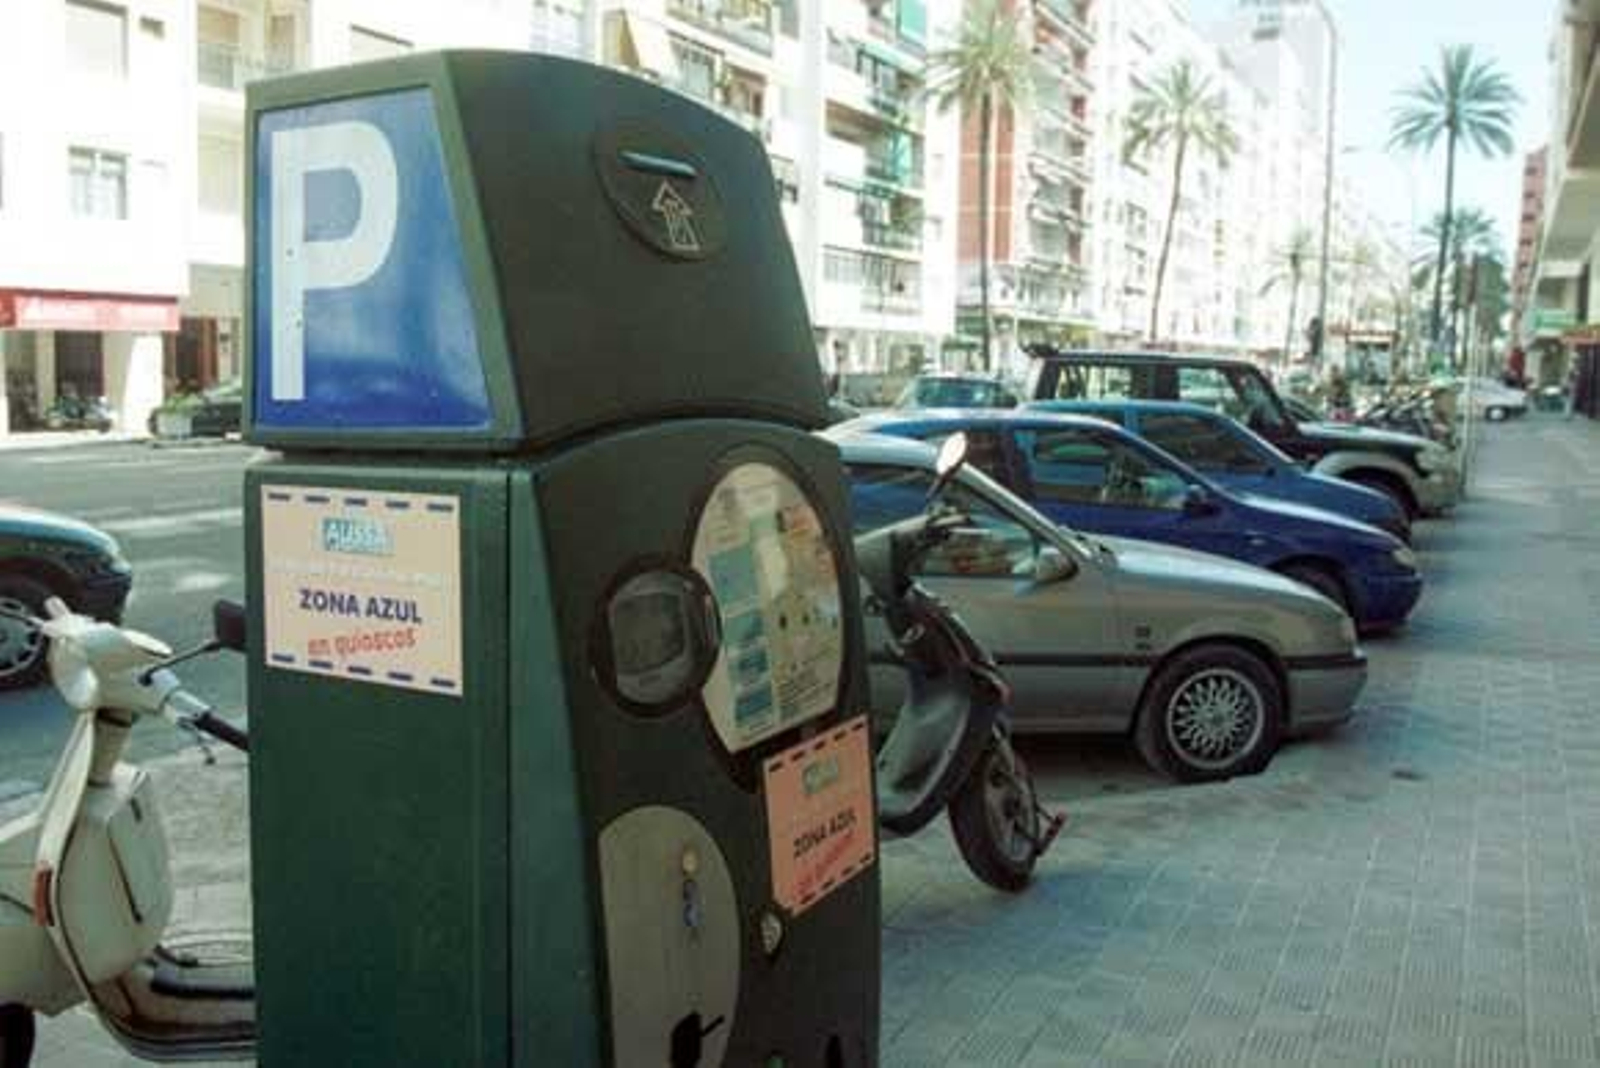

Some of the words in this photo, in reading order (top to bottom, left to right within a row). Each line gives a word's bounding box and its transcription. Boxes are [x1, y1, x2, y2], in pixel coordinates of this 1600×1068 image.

[271, 119, 398, 401] P
[299, 588, 360, 617] ZONA
[366, 597, 422, 624] AZUL
